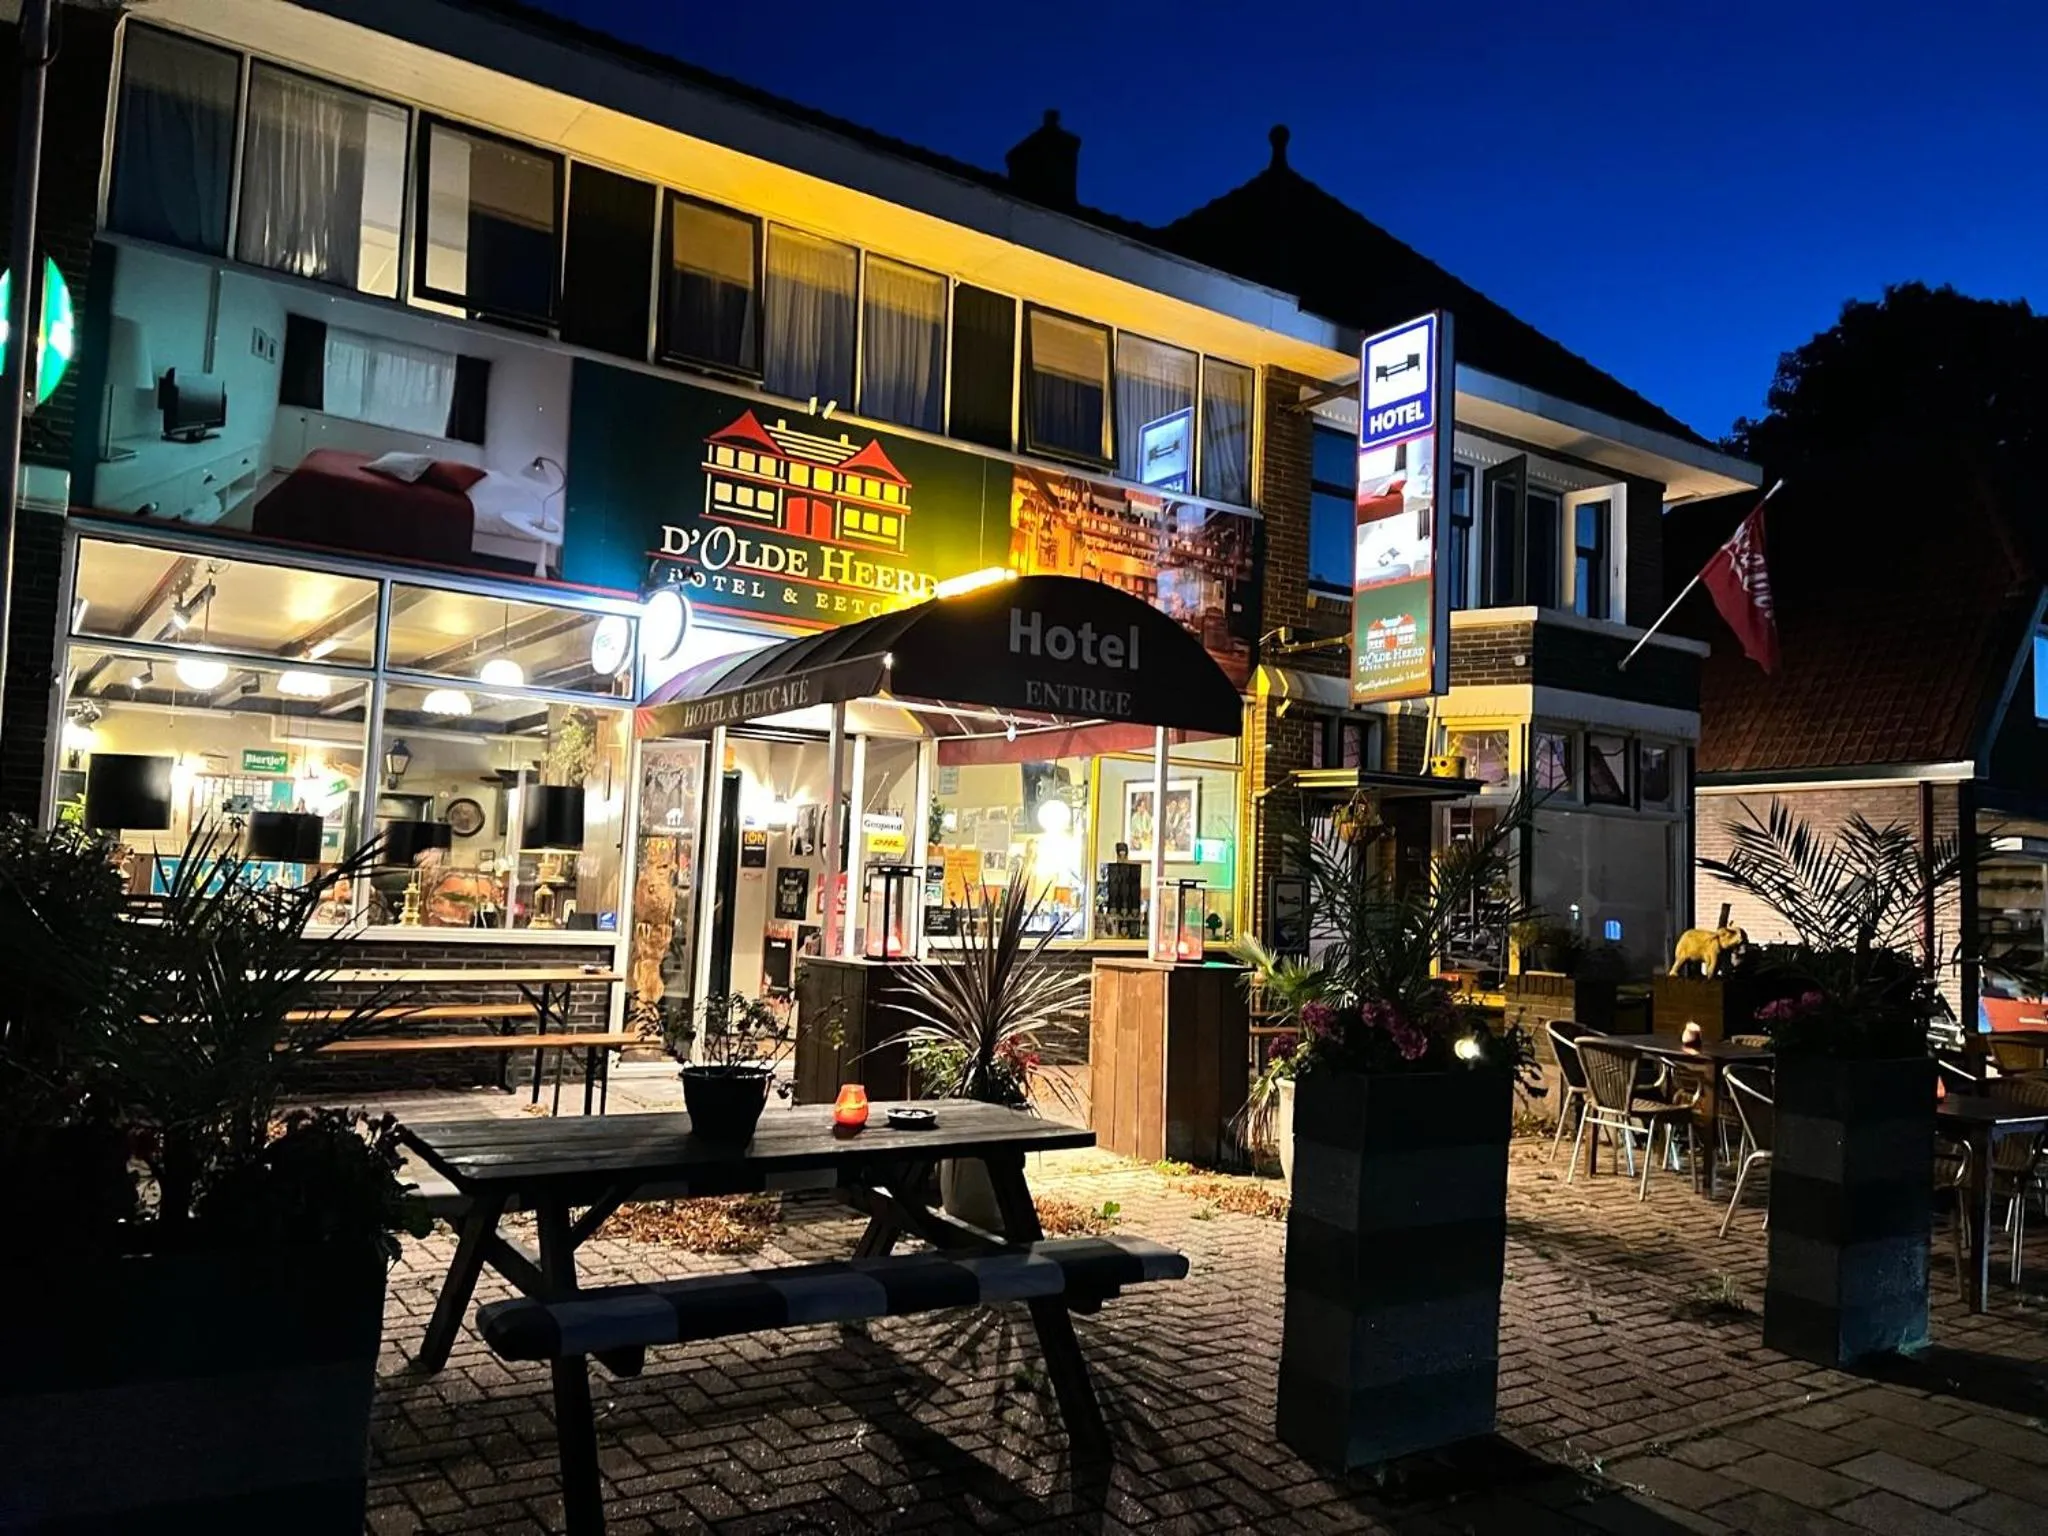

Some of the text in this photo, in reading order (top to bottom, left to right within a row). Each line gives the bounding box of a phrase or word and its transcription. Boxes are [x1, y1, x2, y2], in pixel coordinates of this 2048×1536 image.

[1370, 400, 1425, 435] HOTEL
[660, 525, 938, 598] D'OLDE HEERD
[782, 587, 799, 605] &
[1009, 607, 1139, 670] Hotel
[684, 700, 726, 728] HOTEL
[728, 695, 739, 718] &
[1026, 680, 1132, 716] ENTREE
